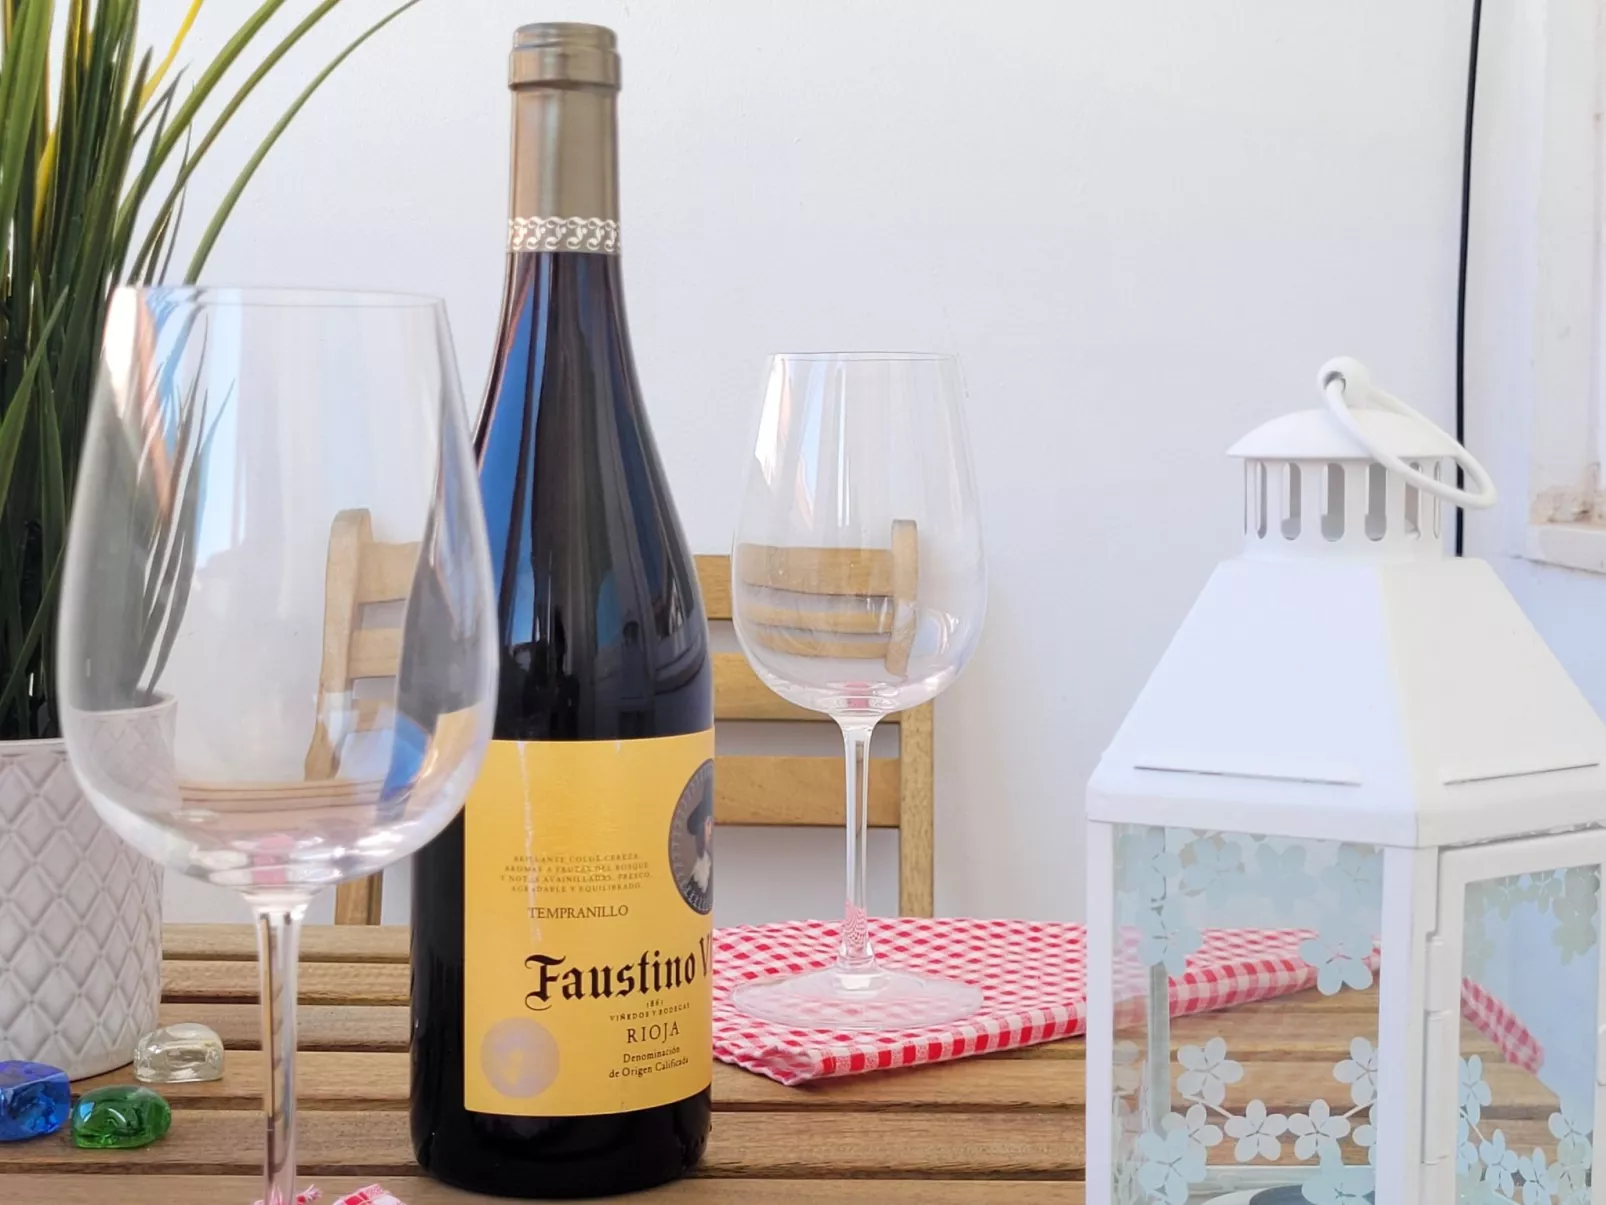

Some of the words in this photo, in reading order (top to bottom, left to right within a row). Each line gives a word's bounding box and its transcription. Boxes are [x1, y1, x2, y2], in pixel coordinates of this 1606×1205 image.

[615, 862, 649, 871] BOSQUE
[528, 904, 629, 919] TEMPRANILLO
[524, 950, 696, 1011] Faustino
[609, 1011, 650, 1022] VIÑEDOS
[626, 1020, 680, 1044] RIOJA
[623, 1046, 680, 1063] Denominación
[609, 1068, 620, 1078] de
[622, 1066, 653, 1078] Origen
[655, 1056, 689, 1072] Calificada
